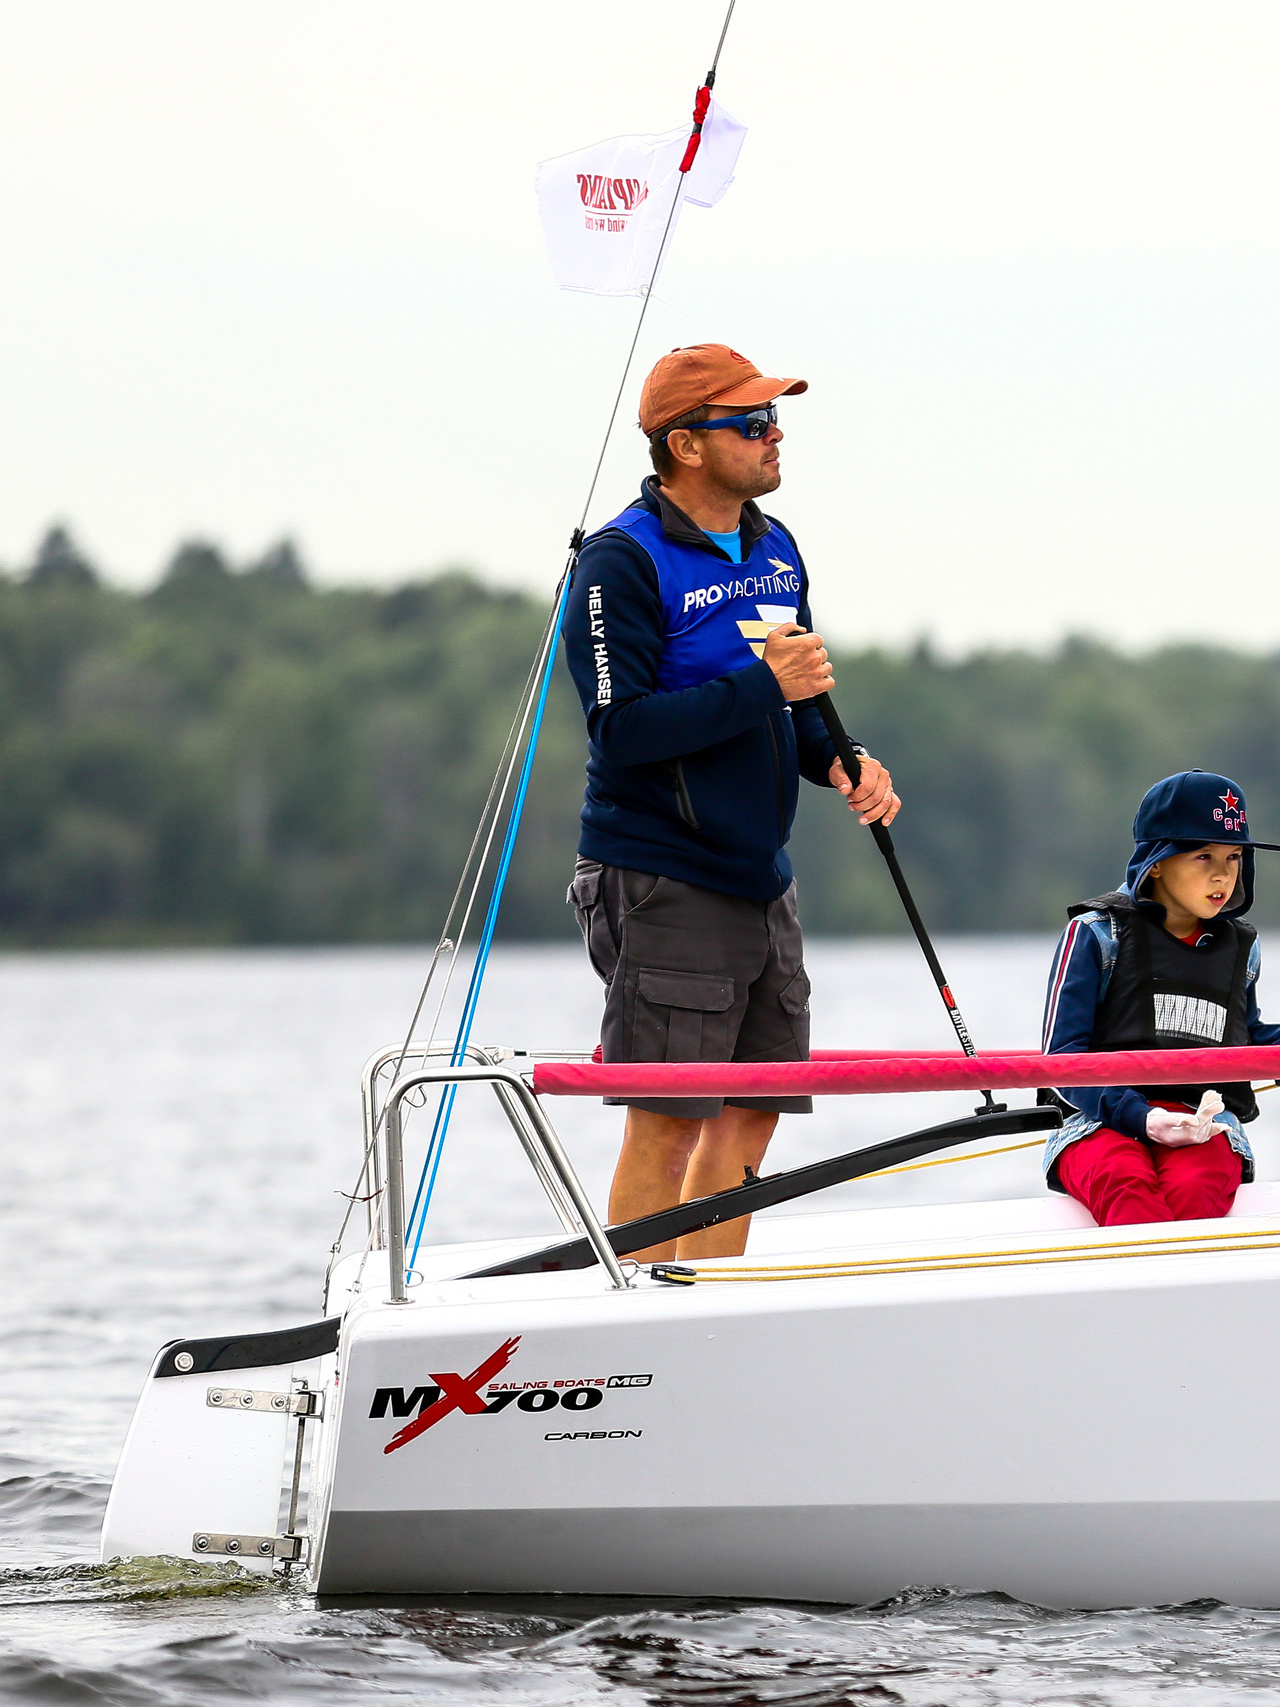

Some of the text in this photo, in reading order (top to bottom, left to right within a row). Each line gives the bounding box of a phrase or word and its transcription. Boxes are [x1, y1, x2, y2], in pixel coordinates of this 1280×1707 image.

[588, 585, 605, 638] HELLY
[487, 1375, 651, 1392] SAILING BOATS MG
[543, 1430, 643, 1442] CARBON
